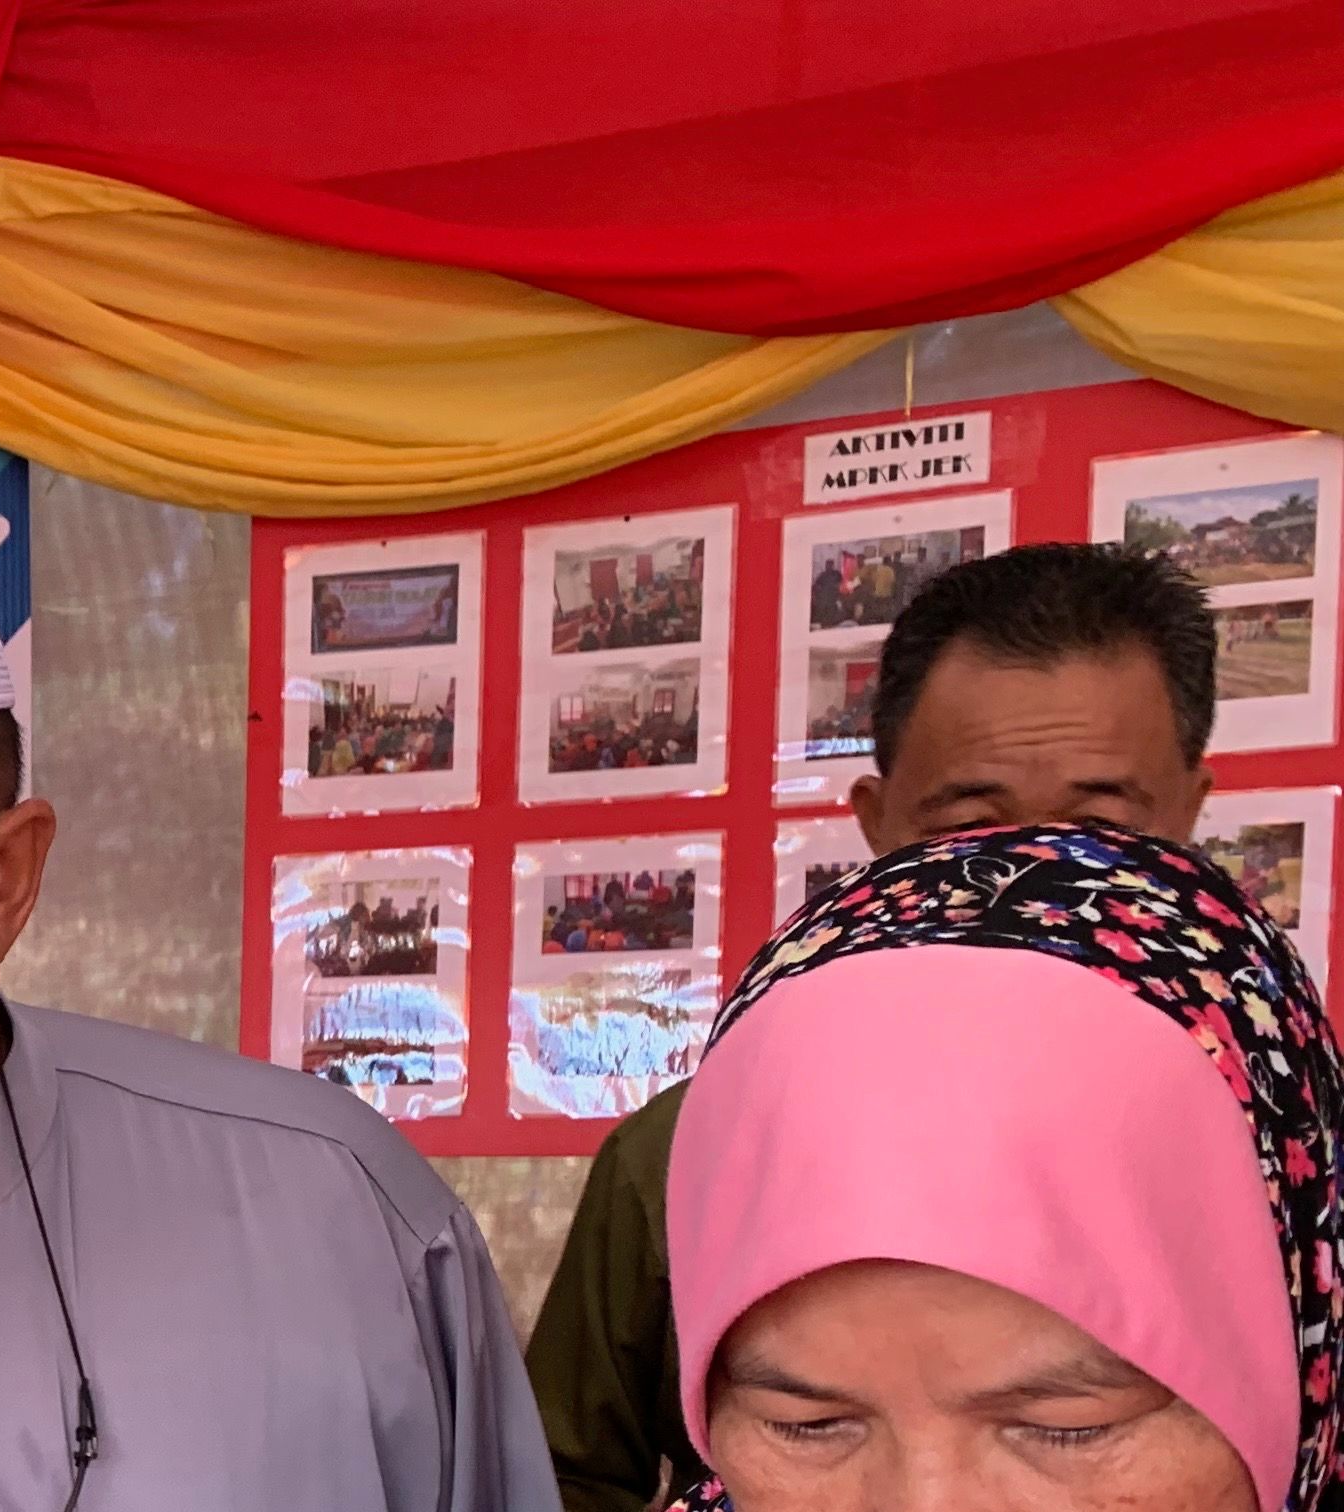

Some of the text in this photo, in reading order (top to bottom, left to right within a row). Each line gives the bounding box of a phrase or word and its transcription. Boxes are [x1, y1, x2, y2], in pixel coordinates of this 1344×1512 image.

[828, 421, 965, 459] AKTIVITI
[820, 453, 973, 493] MPKK JEK
